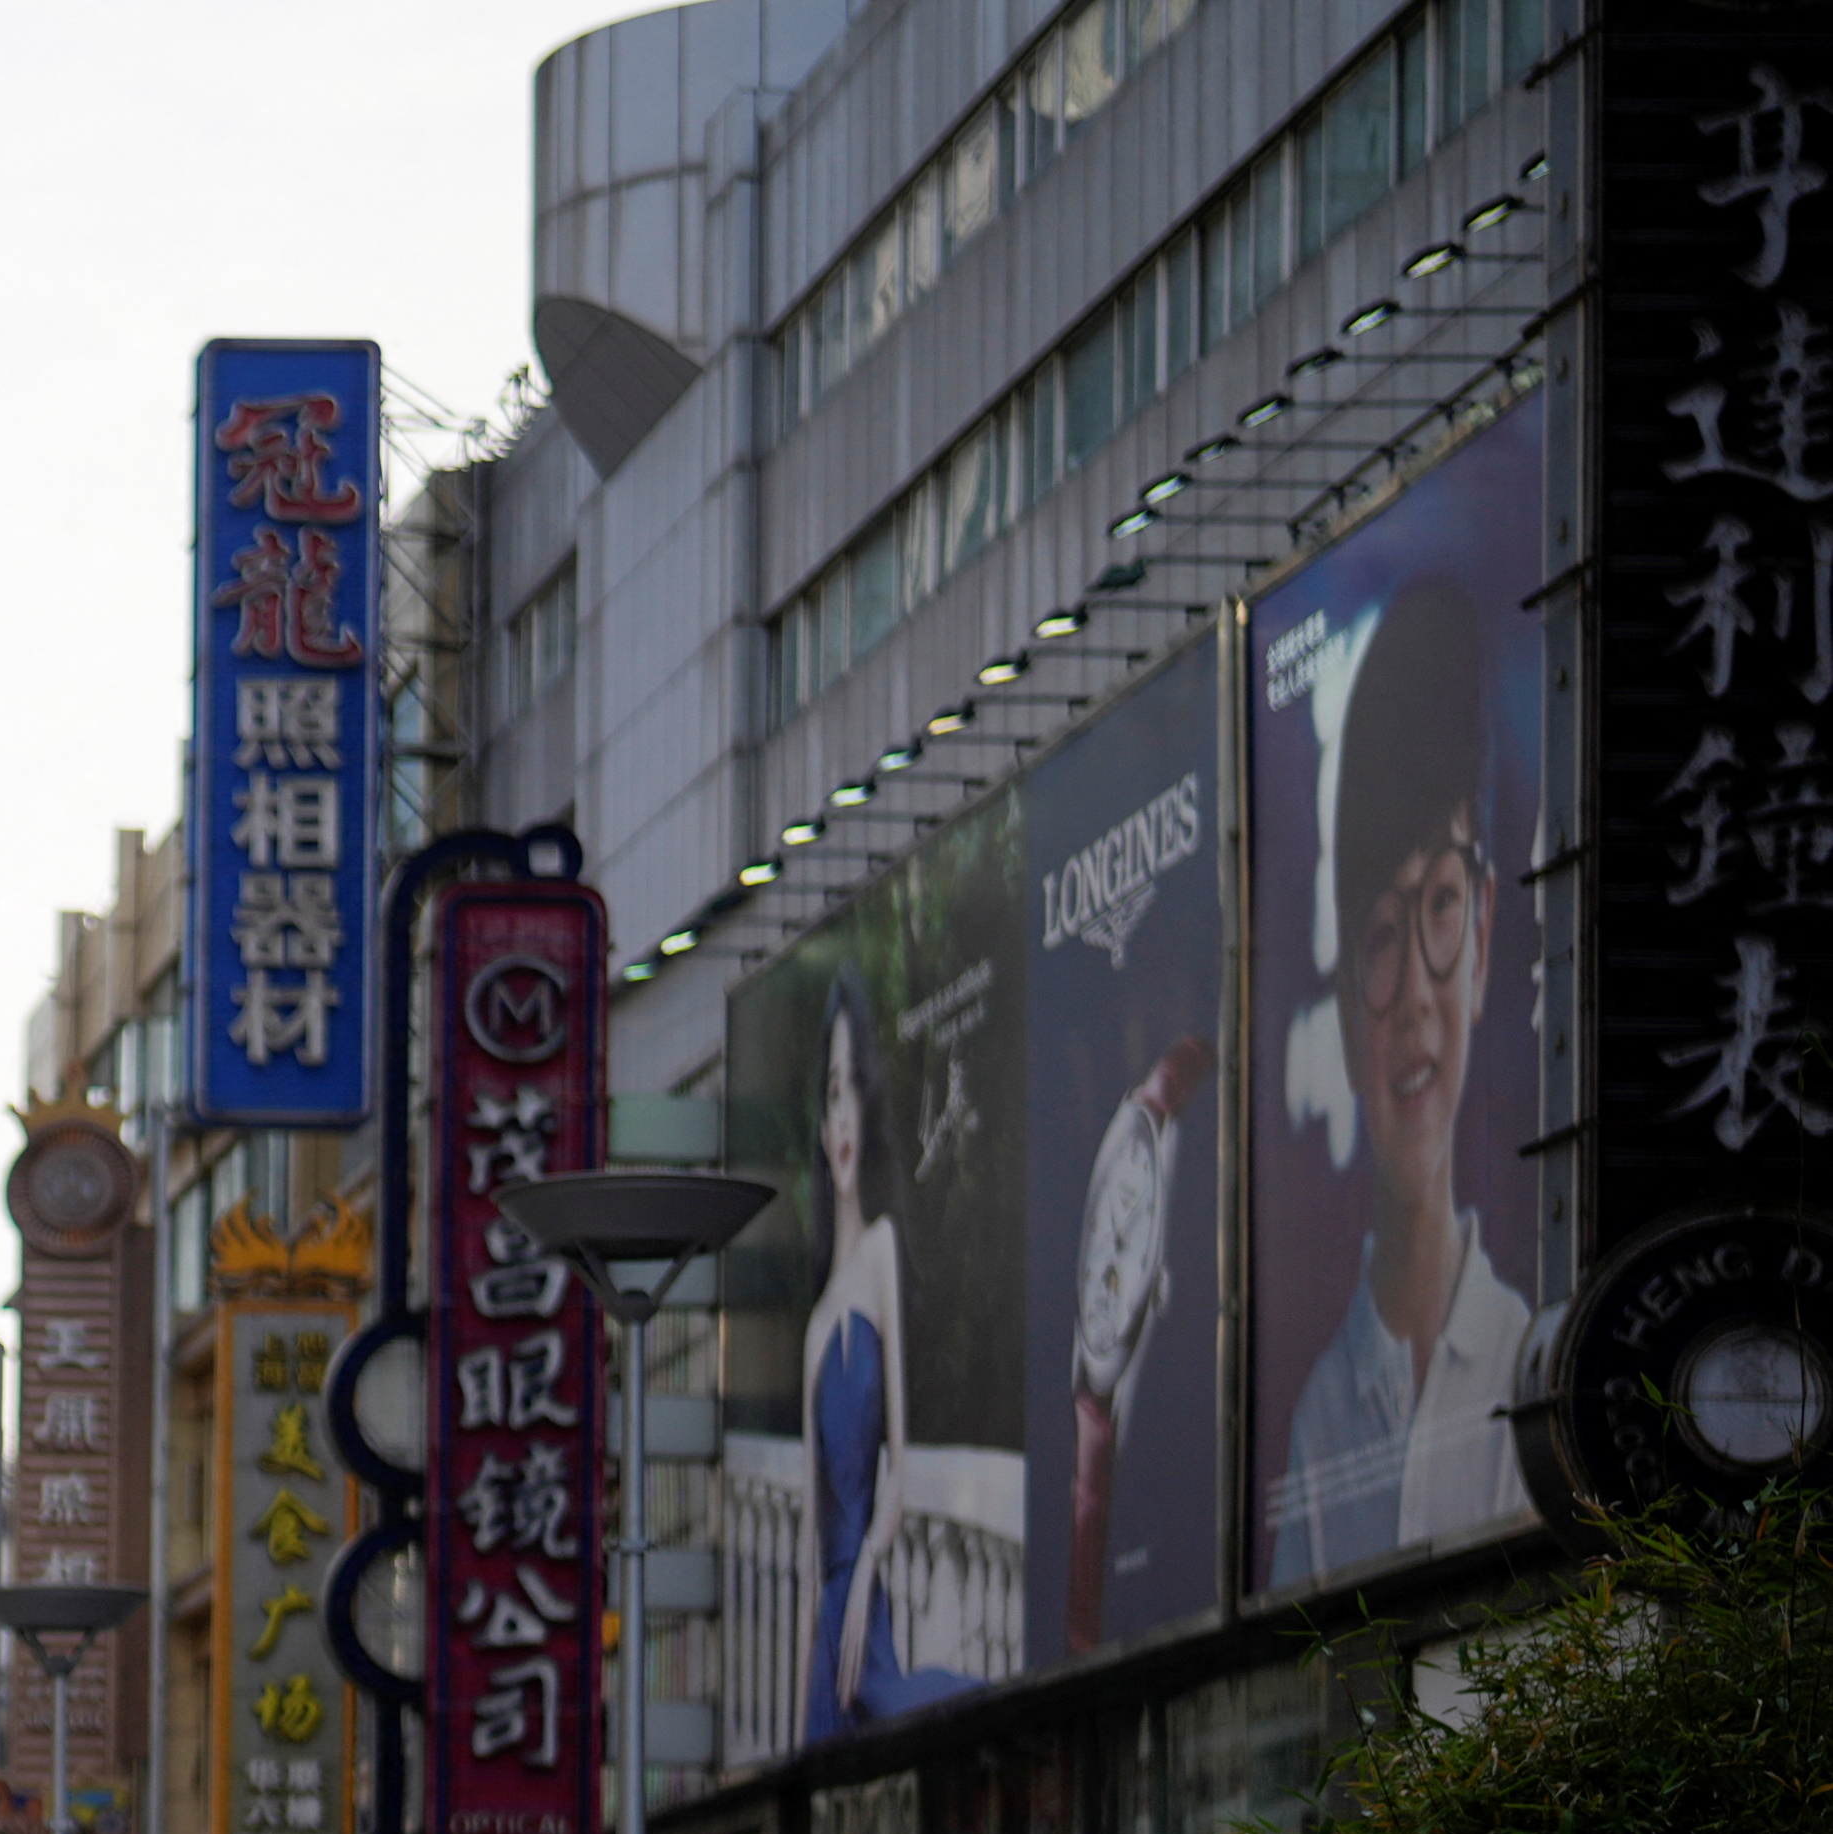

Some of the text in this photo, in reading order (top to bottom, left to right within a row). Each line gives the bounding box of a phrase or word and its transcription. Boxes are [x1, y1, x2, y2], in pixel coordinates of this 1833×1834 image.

[213, 393, 363, 1068] 冠龍照相器材
[1041, 772, 1201, 950] LONGINES
[250, 1402, 332, 1745] 美食广场
